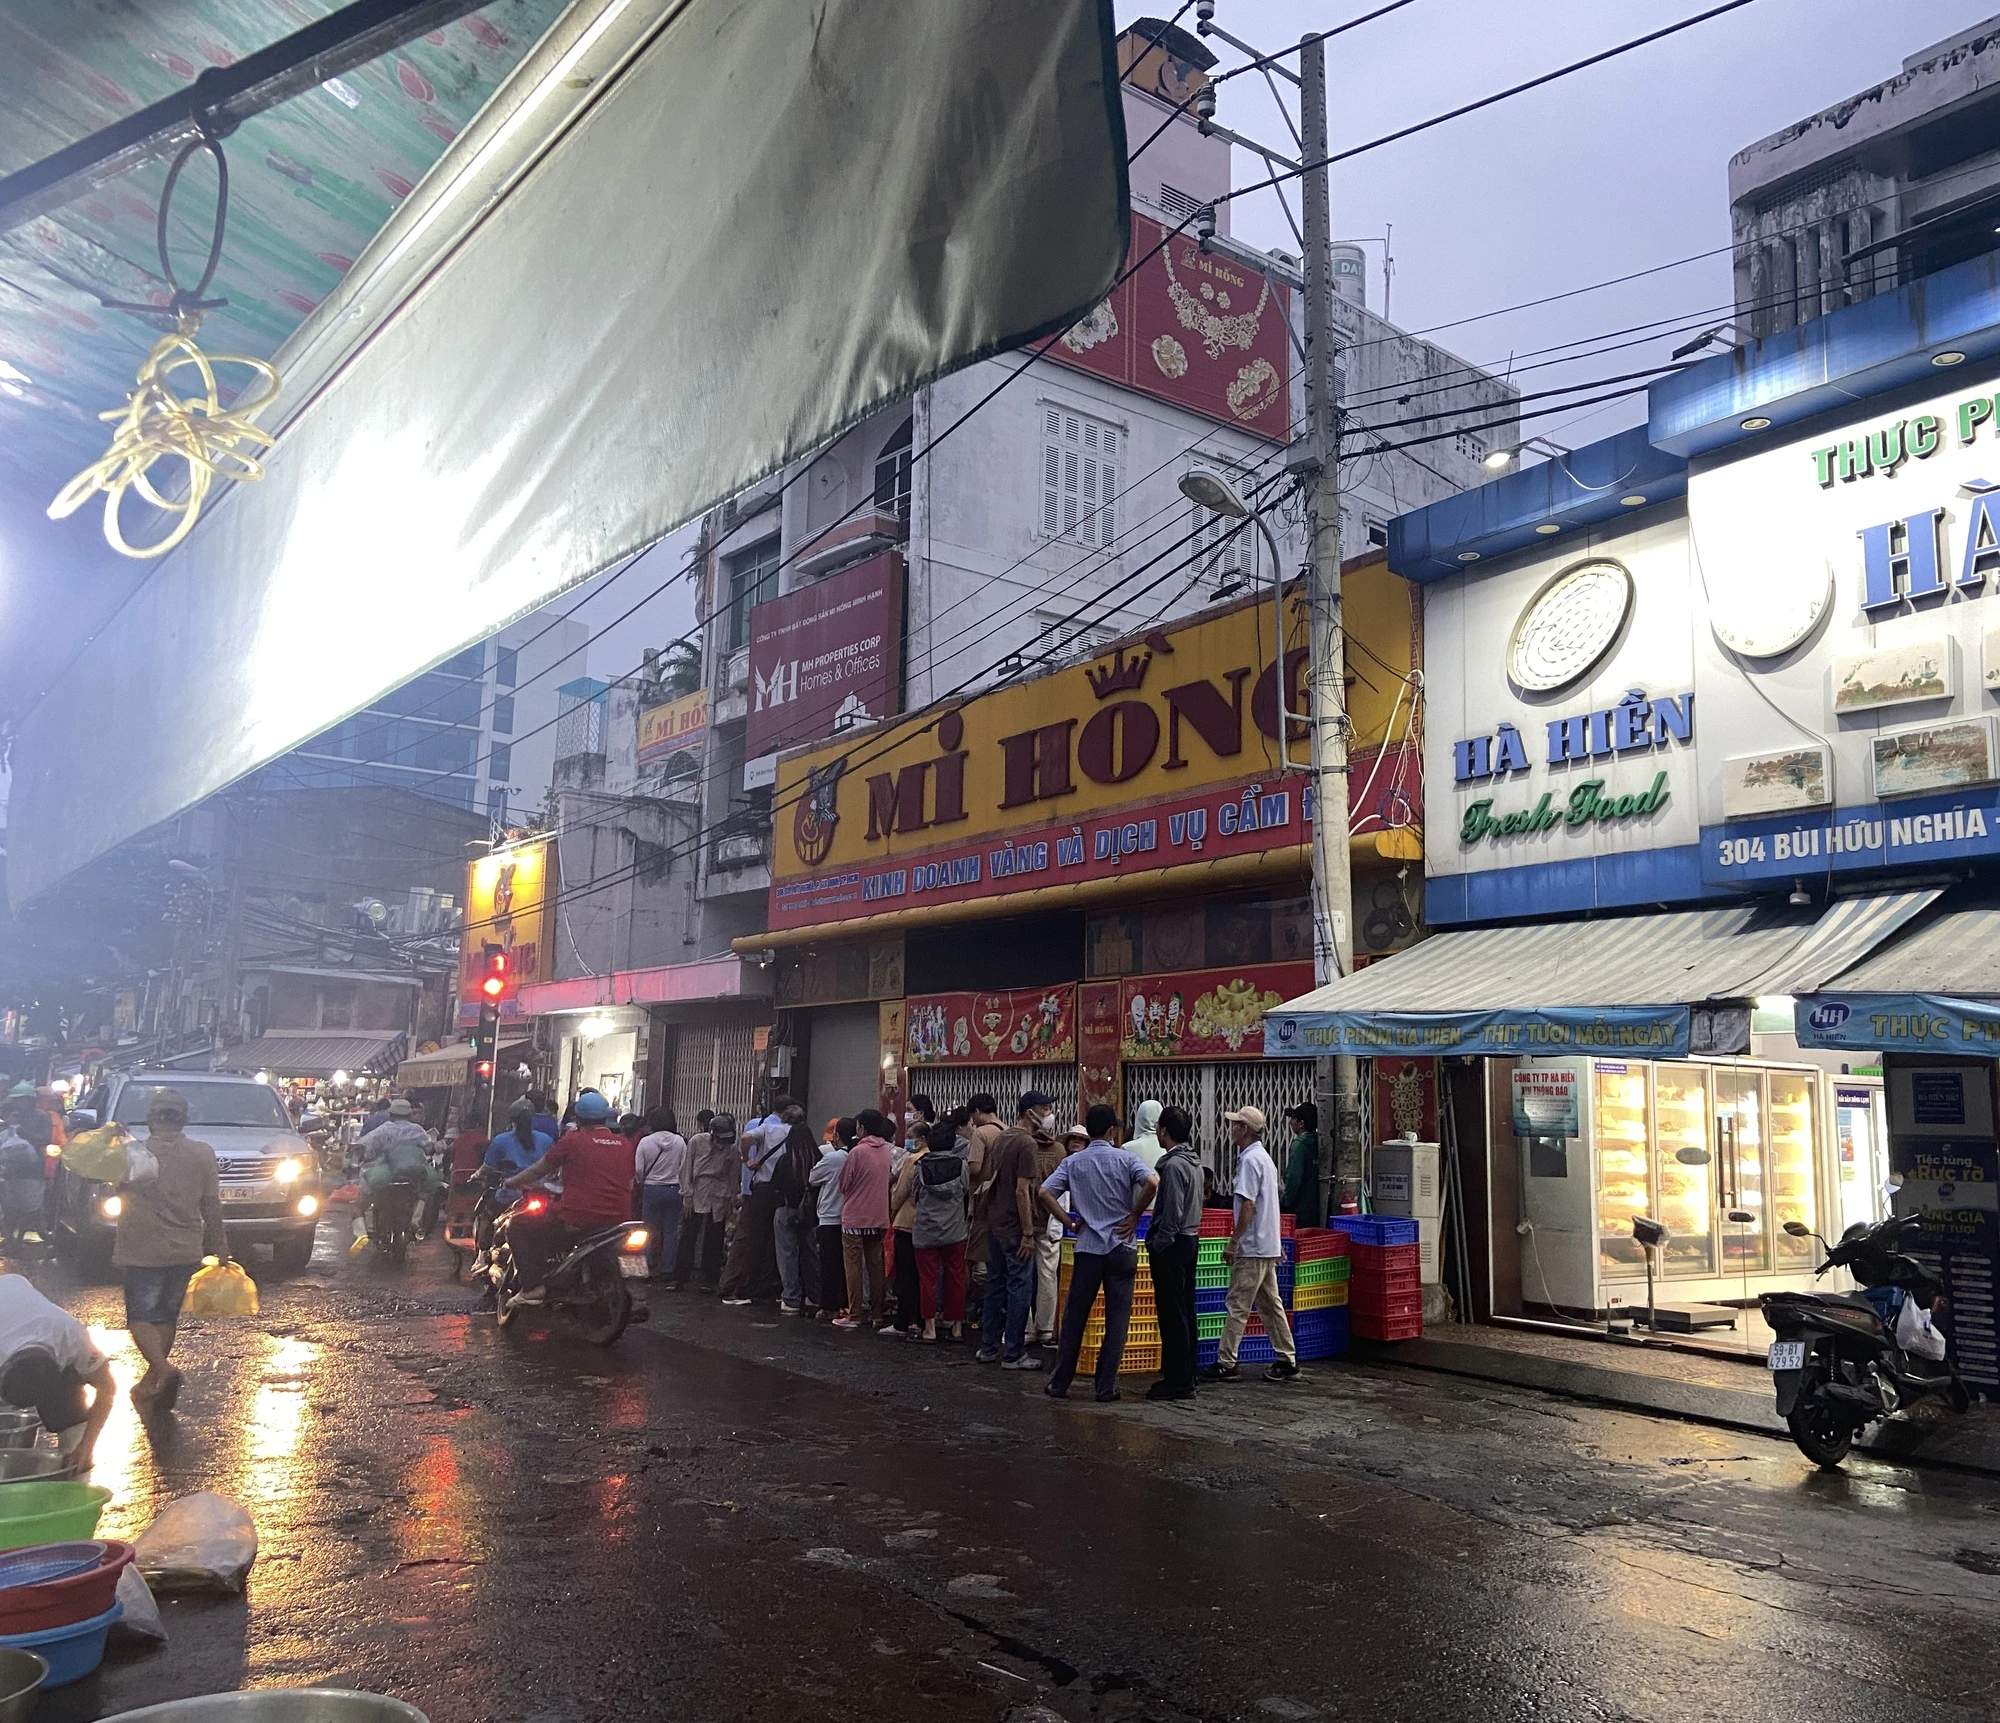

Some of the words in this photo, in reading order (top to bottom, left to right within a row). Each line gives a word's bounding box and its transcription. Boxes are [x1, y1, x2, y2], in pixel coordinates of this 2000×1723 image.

[1811, 415, 1940, 485] THỰC
[1958, 392, 2000, 443] P
[756, 633, 770, 644] CÔNG
[770, 630, 778, 638] TY
[778, 625, 791, 635] TNHH
[818, 610, 828, 620] SẢN
[829, 607, 836, 616] MI
[836, 601, 851, 612] HỒNG
[852, 595, 867, 606] MINH
[802, 659, 814, 673] MH
[815, 643, 858, 668] PROPERTIES
[860, 635, 881, 652] CORP
[800, 670, 833, 693] Homes
[835, 663, 843, 681] &
[845, 654, 880, 678] Offices
[998, 632, 1355, 809] HỒNG
[1454, 722, 1532, 781] HÀ
[1545, 688, 1694, 763] HIỀN
[1460, 792, 1562, 842] Fresh
[1565, 771, 1670, 825] Food
[862, 870, 906, 901] KINH
[912, 855, 982, 893] DOANH
[989, 840, 1048, 878] VÀNG
[1056, 826, 1085, 867] VÀ
[1094, 819, 1157, 864] DỊCH
[1169, 809, 1207, 850] VỤ
[1218, 784, 1289, 835] CẦM
[1719, 836, 1765, 866] 304
[1774, 825, 1819, 861] BÙI
[1826, 818, 1883, 854] HỮU
[1891, 804, 1988, 847] NGHĨA
[1281, 1024, 1294, 1036] HH
[1304, 1024, 1341, 1046] THỰC
[1343, 1019, 1393, 1046] PHẨM
[1482, 1023, 1522, 1048] THỊT
[1526, 1022, 1570, 1044] TƯƠI
[1574, 1014, 1613, 1046] MỖI
[1618, 1019, 1679, 1046] NGÀY
[1814, 1008, 1844, 1023] HH
[1870, 1013, 1950, 1044] THỰC
[1514, 1071, 1531, 1083] CÔNG
[1533, 1073, 1540, 1083] TY
[1541, 1073, 1549, 1083] TP
[1551, 1071, 1559, 1083] HÀ
[1533, 1084, 1554, 1096] THÔNG
[1555, 1084, 1568, 1096] BÁO
[1915, 1154, 1940, 1166] Tiệc
[1943, 1154, 1973, 1167] tùng
[1774, 1344, 1798, 1356] 59-B1
